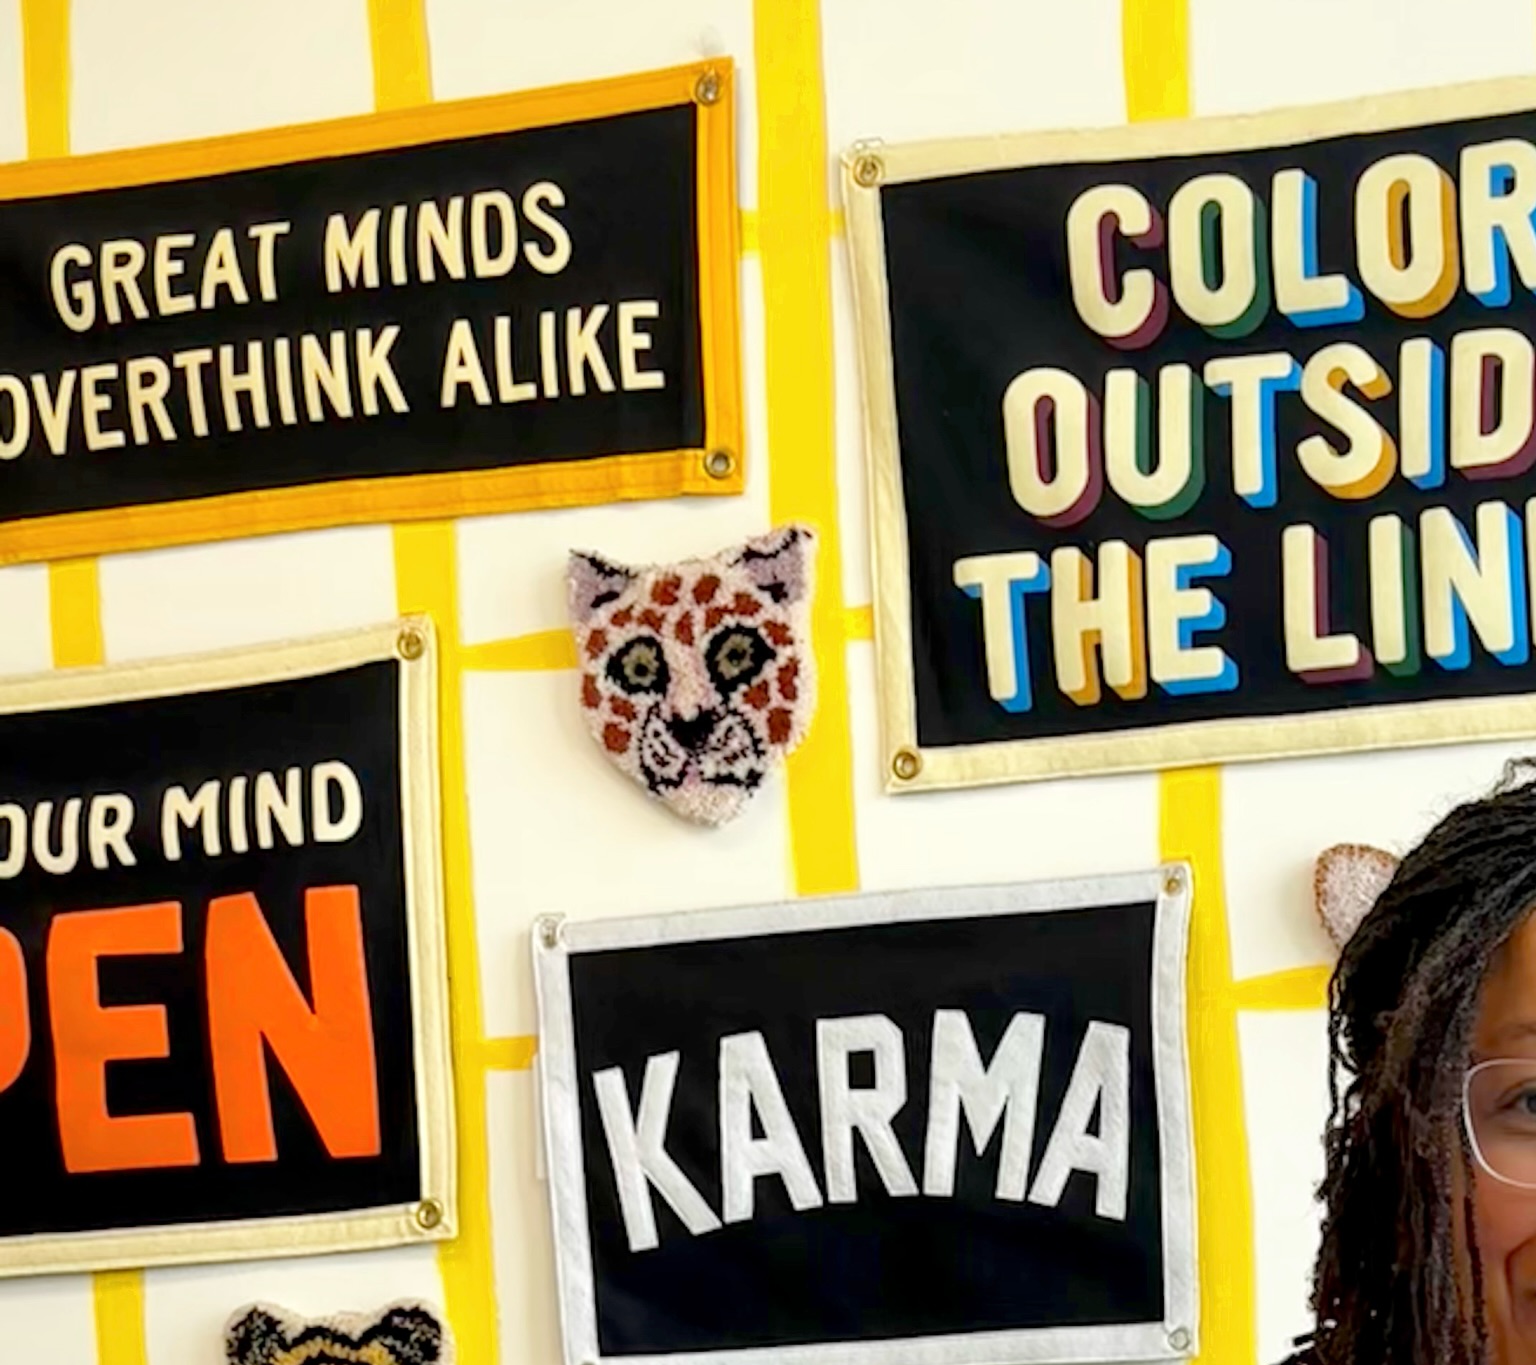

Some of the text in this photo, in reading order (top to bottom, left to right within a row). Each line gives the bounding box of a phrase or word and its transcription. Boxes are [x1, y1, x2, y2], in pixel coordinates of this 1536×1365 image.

[50, 181, 572, 332] GREAT MINDS
[0, 301, 665, 460] OVERTHINK ALIKE
[953, 533, 1239, 712] THE
[162, 761, 364, 860] MIND
[593, 1008, 1130, 1252] KARMA
